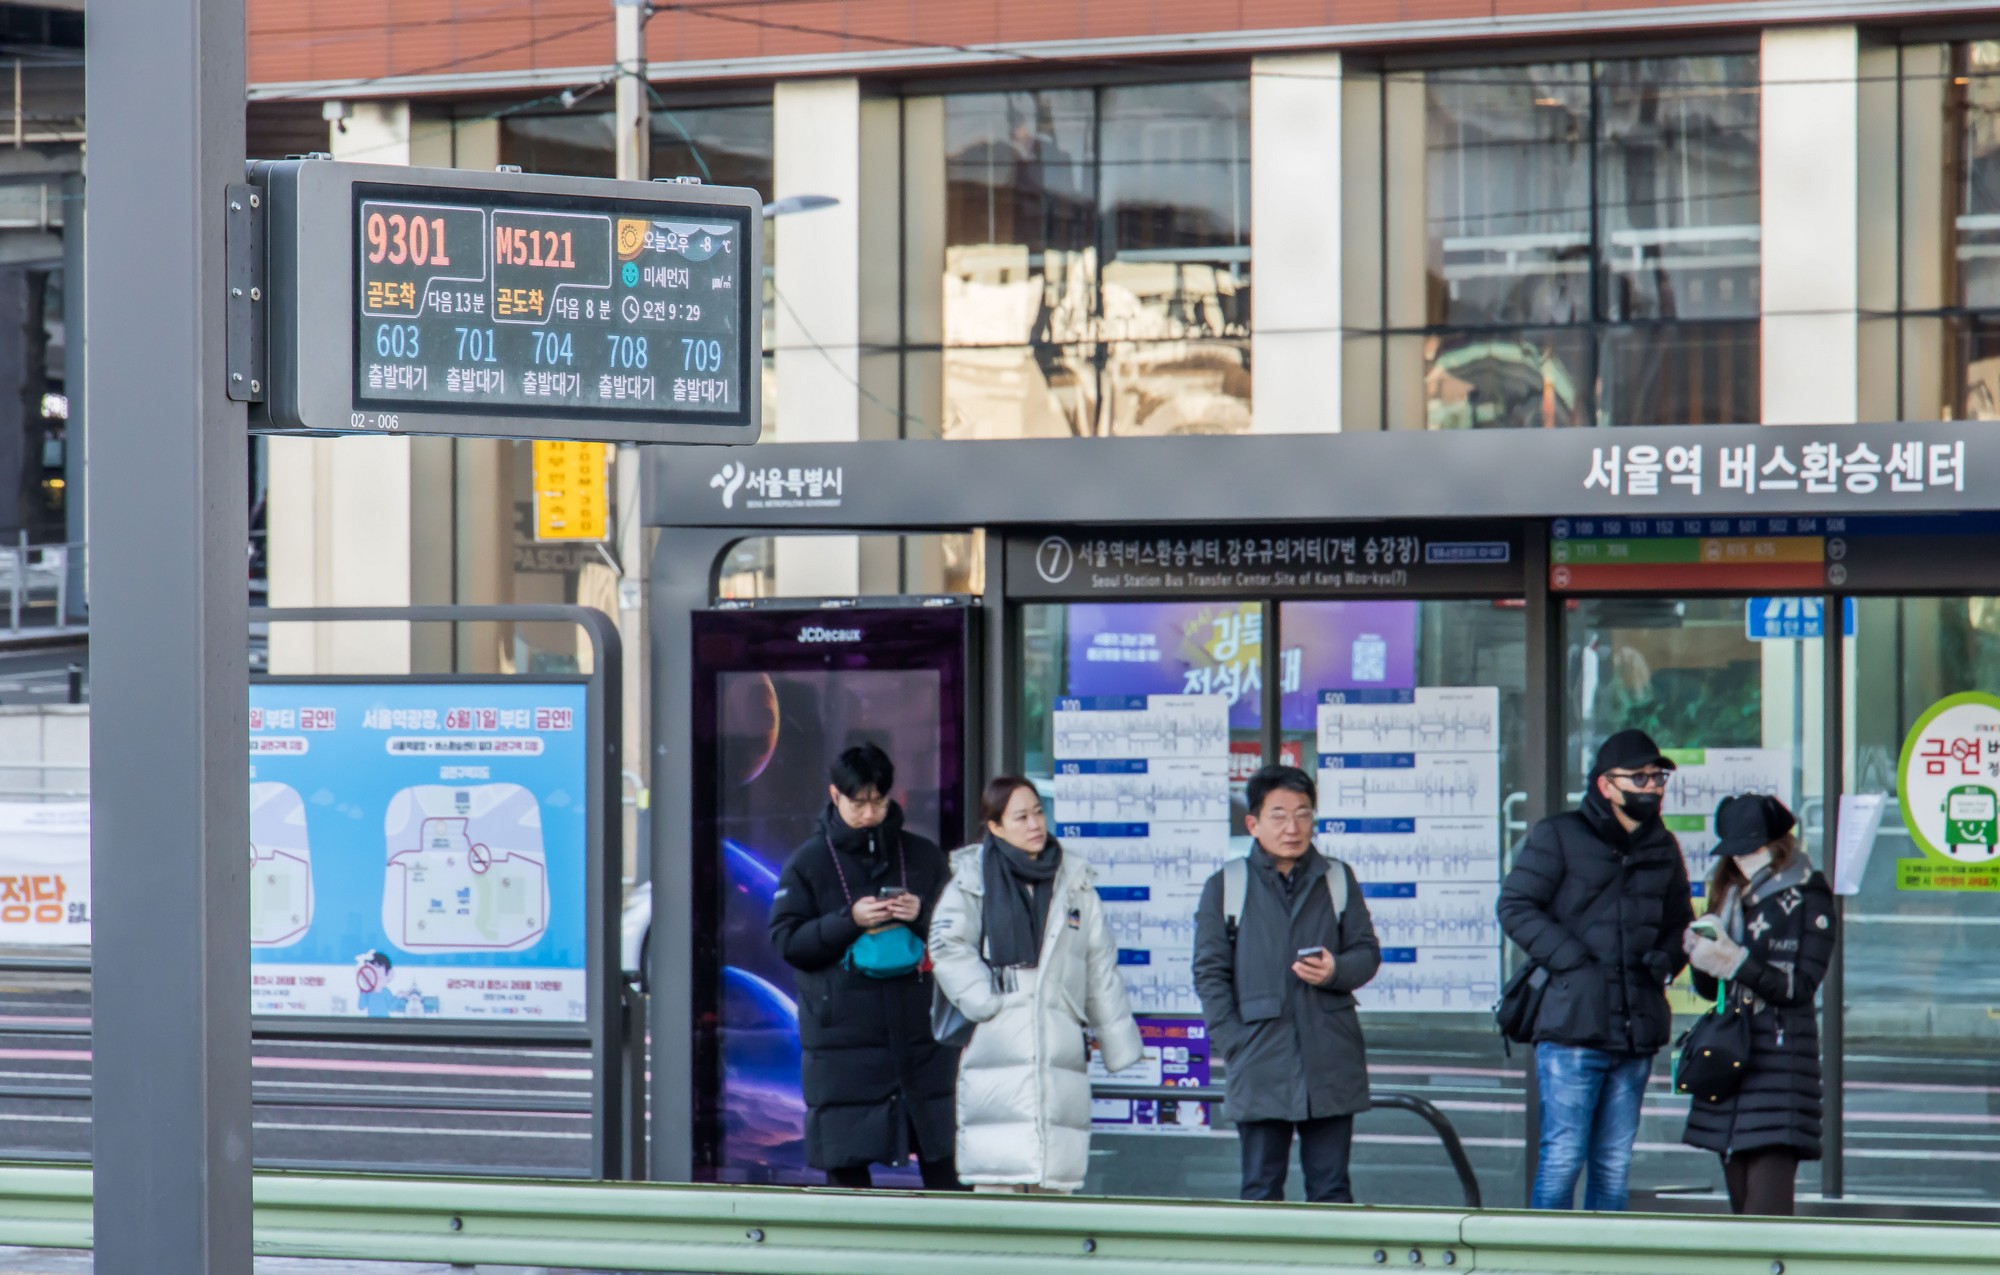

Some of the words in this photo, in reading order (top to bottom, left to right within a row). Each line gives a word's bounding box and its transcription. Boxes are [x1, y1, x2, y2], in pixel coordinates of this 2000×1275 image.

[367, 212, 451, 267] 9301
[495, 225, 576, 269] M5121
[644, 265, 689, 290] 미세먼지
[367, 280, 416, 310] 곧도착
[428, 289, 453, 314] 다음
[496, 287, 544, 317] 곧도착
[555, 296, 580, 320] 다음
[642, 300, 666, 322] 오전
[376, 322, 420, 360] 603
[454, 326, 497, 363] 701
[531, 331, 574, 366] 704
[606, 334, 648, 370] 708
[681, 337, 722, 373] 709
[368, 363, 429, 391] 출발대기
[446, 366, 505, 395] 출발대기
[522, 370, 581, 398] 출발대기
[598, 373, 656, 402] 출발대기
[672, 376, 729, 405] 출발대기
[746, 466, 843, 498] 서울특별시
[1583, 444, 1703, 496] 서울역
[1718, 440, 1965, 496] 버스환승센터
[1091, 572, 1121, 588] Seoul
[1124, 572, 1161, 588] Station
[1164, 572, 1184, 588] Bus
[1187, 571, 1232, 587] Transfer
[1298, 571, 1311, 586] of
[1314, 571, 1342, 588] Kang
[798, 626, 862, 643] JCDecaux
[301, 708, 335, 729] 금연!
[445, 708, 471, 729] 6월
[536, 708, 572, 729] 금연!
[1920, 736, 1981, 776] 금연
